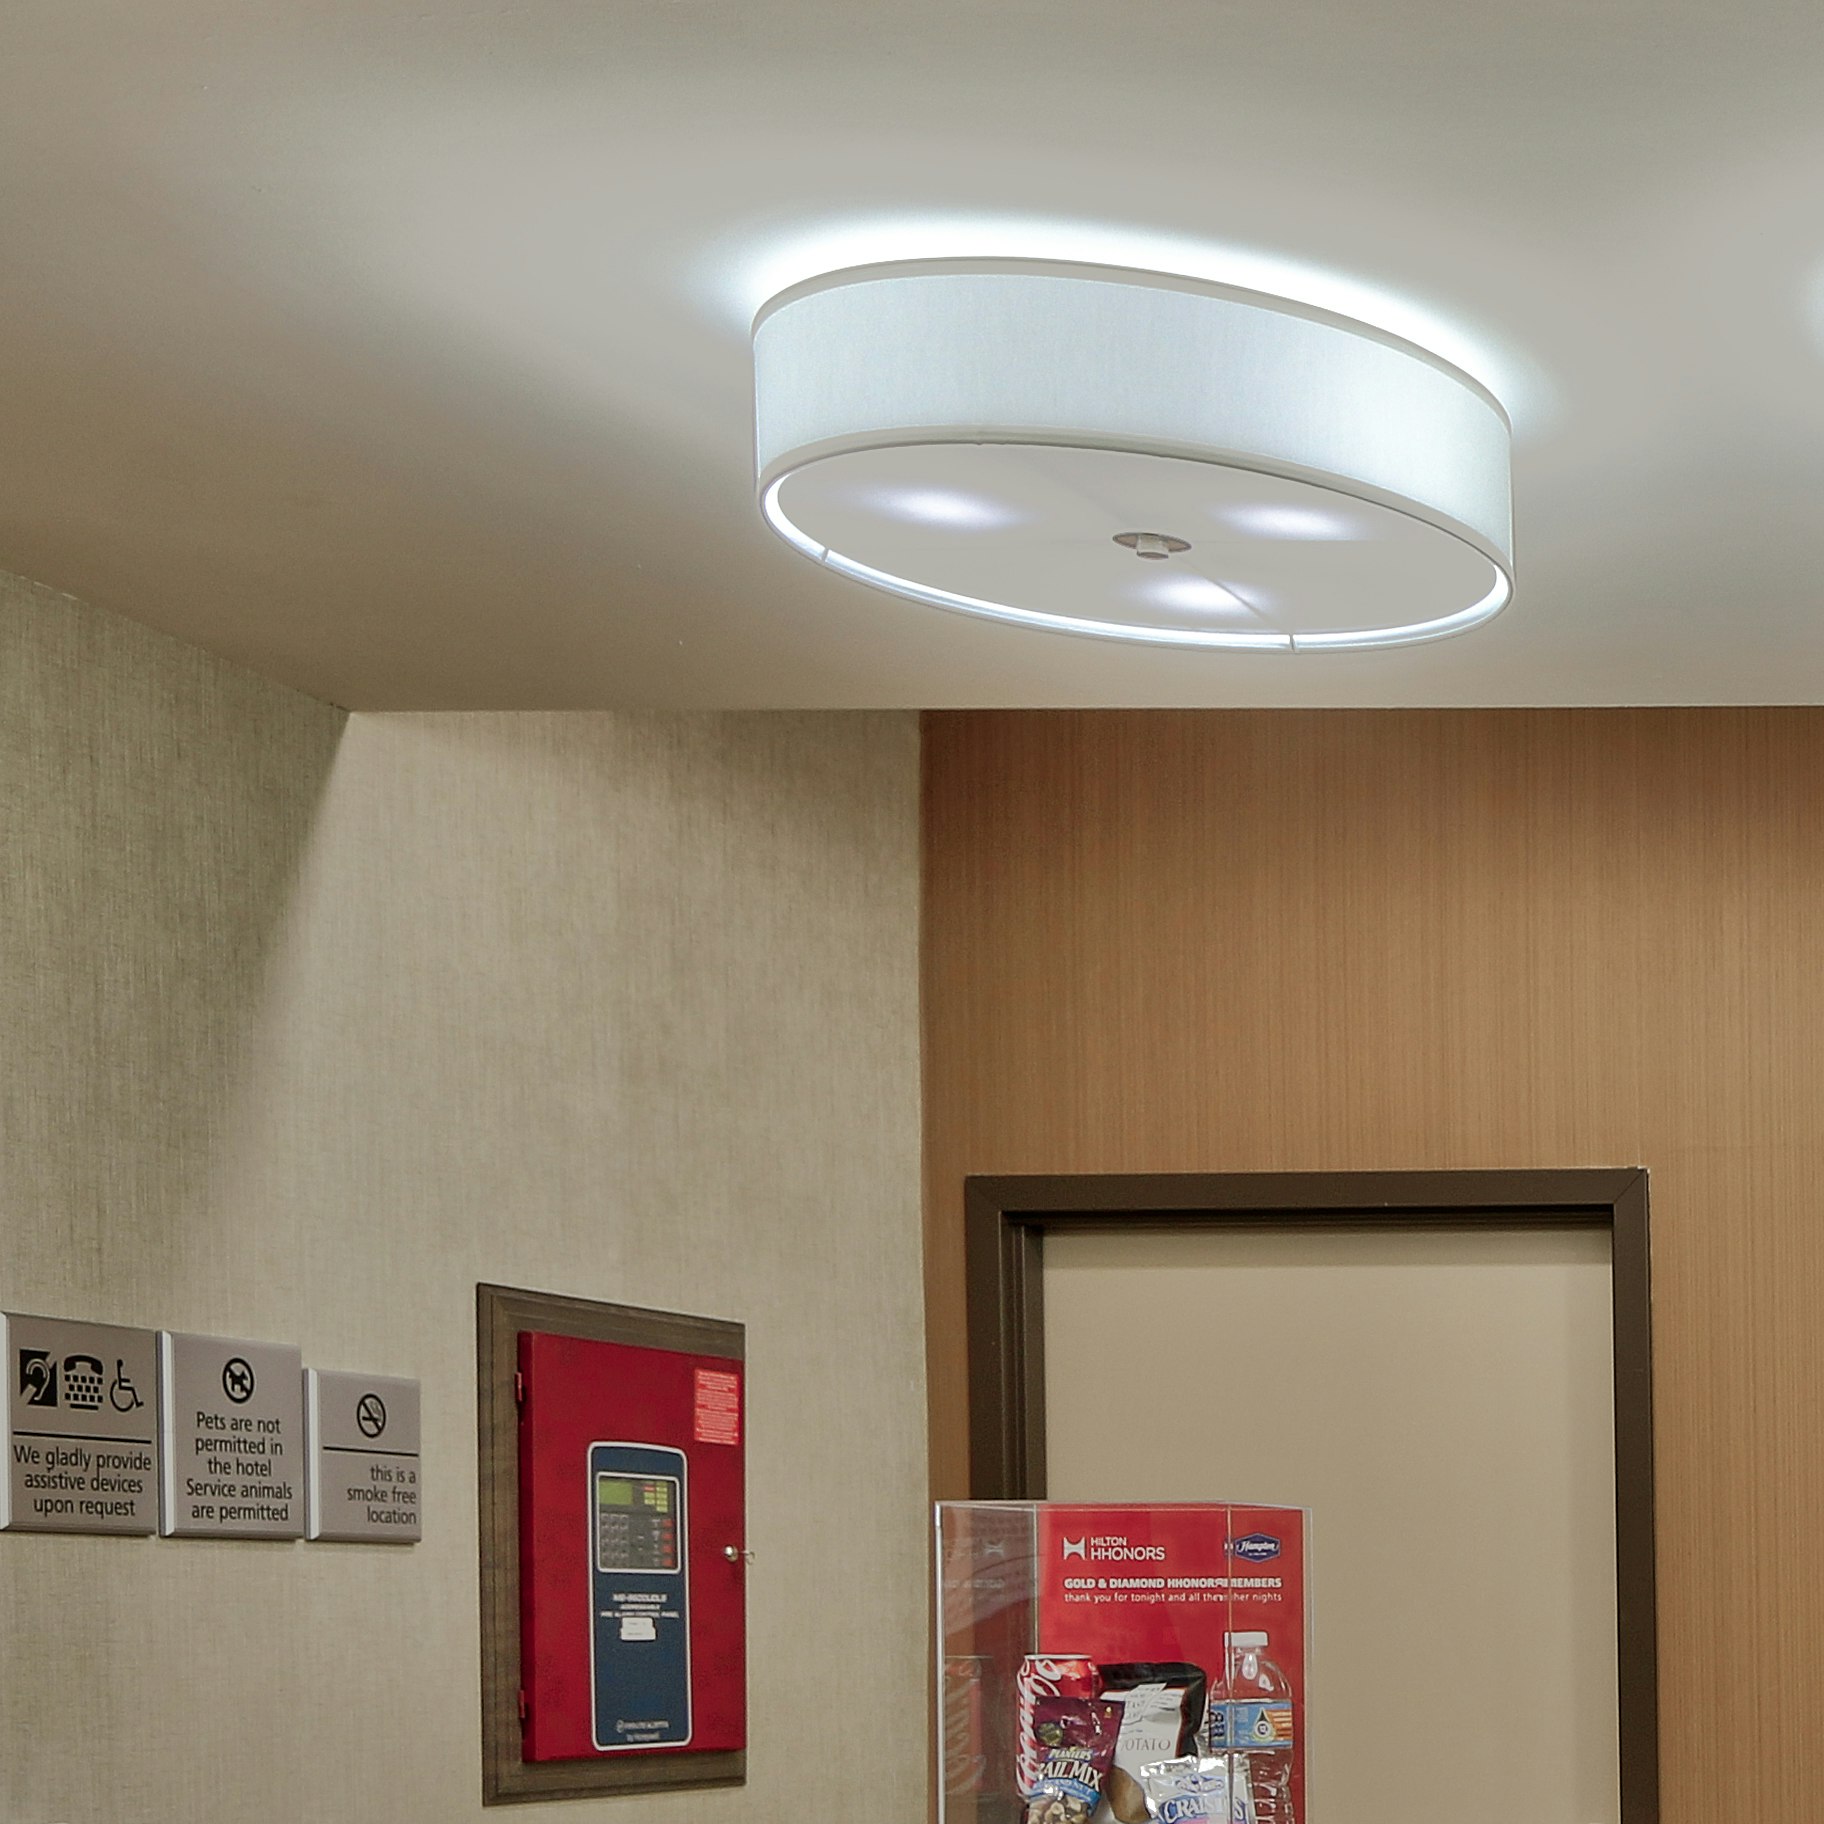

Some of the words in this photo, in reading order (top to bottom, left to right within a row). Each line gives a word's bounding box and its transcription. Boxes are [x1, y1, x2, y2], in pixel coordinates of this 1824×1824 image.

[196, 1412, 226, 1431] Pets
[230, 1417, 253, 1432] are
[257, 1417, 281, 1433] not
[195, 1436, 264, 1457] permitted
[270, 1439, 283, 1456] in
[13, 1445, 40, 1465] We
[46, 1446, 91, 1472] gladly
[96, 1450, 152, 1473] provide
[208, 1458, 231, 1476] the
[235, 1459, 272, 1477] hotel
[24, 1469, 86, 1491] assistive
[91, 1472, 143, 1494] devices
[371, 1466, 394, 1483] this
[396, 1468, 405, 1483] is
[407, 1473, 416, 1484] a
[186, 1479, 236, 1498] Service
[241, 1481, 292, 1500] animals
[347, 1486, 388, 1503] smoke
[391, 1487, 417, 1504] free
[33, 1499, 74, 1518] upon
[79, 1499, 135, 1519] request
[191, 1506, 214, 1520] are
[219, 1502, 289, 1524] permitted
[367, 1506, 417, 1525] location
[1091, 1537, 1127, 1547] HILTON
[1091, 1547, 1165, 1560] HHONORS
[1064, 1577, 1095, 1588] GOLD
[1098, 1577, 1107, 1588] &
[1110, 1577, 1164, 1588] DIAMOND
[1065, 1592, 1090, 1602] thank
[1094, 1594, 1110, 1604] you
[1114, 1592, 1127, 1602] for
[1131, 1592, 1165, 1603] tonight
[1169, 1592, 1185, 1602] and
[1189, 1592, 1200, 1602] all
[1252, 1592, 1282, 1604] nights
[1069, 1760, 1103, 1792] MIX
